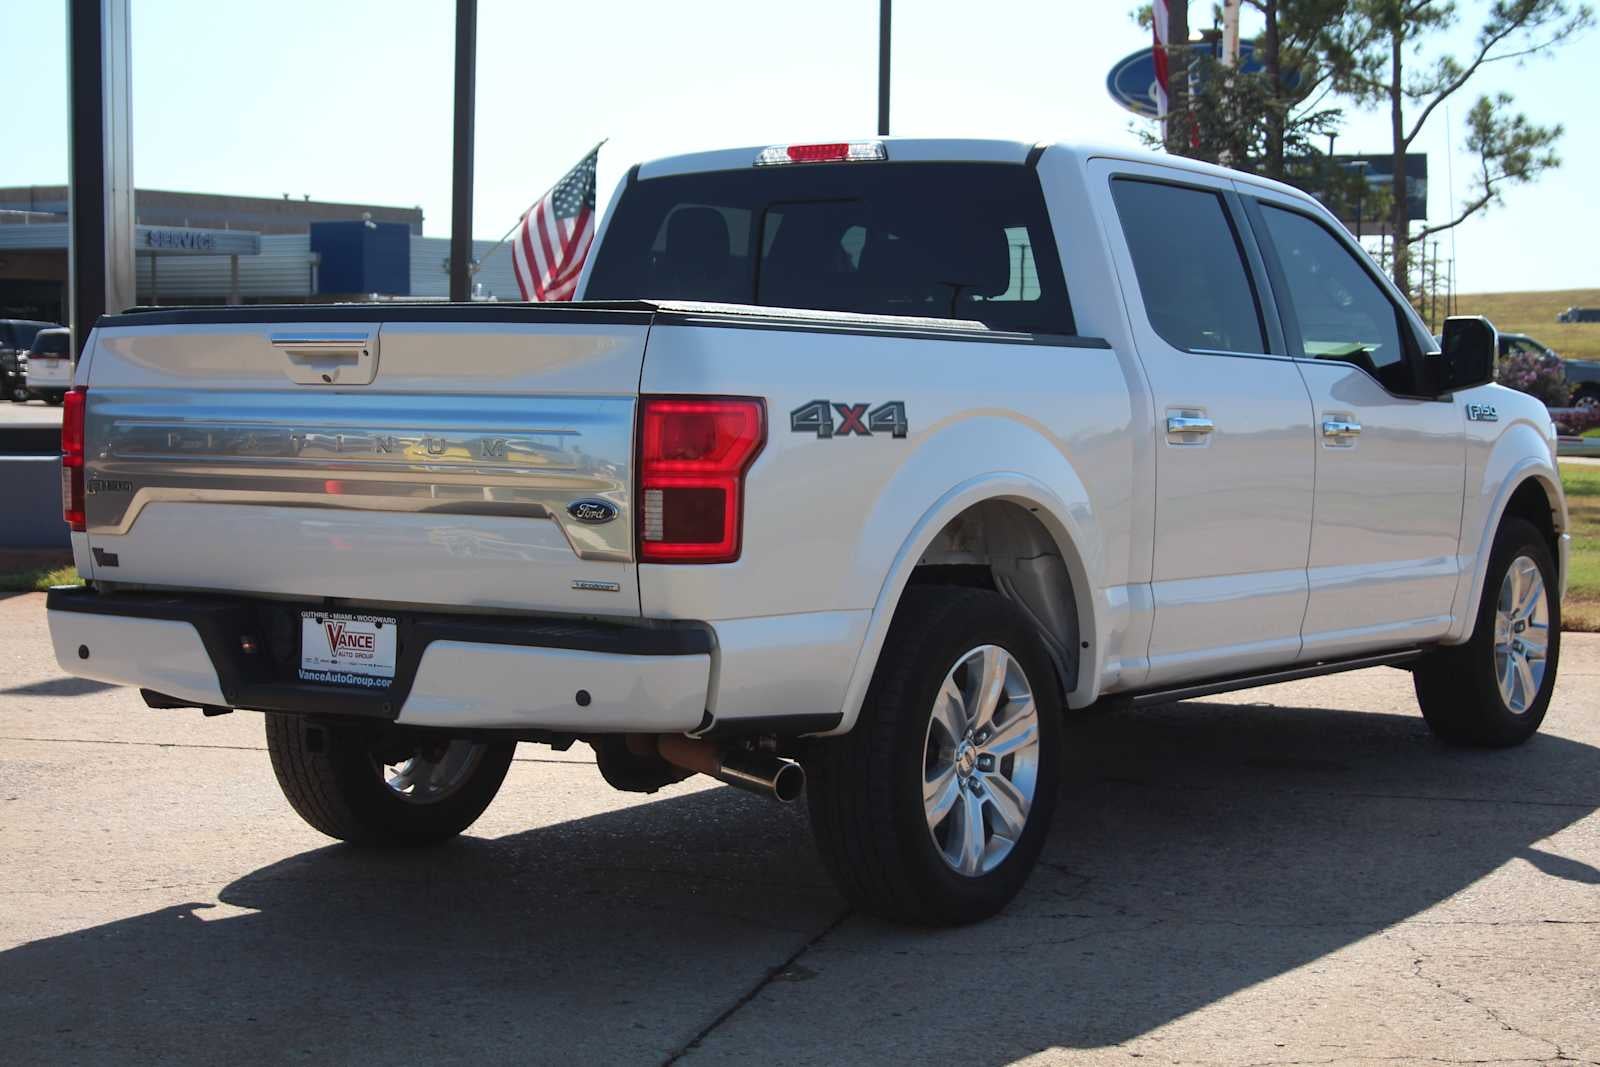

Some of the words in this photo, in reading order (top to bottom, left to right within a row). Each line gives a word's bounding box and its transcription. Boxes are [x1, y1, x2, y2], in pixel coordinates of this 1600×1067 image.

[576, 503, 605, 519] Ford
[301, 611, 329, 619] GUTHRIE
[333, 612, 353, 620] MIAMI
[356, 614, 397, 624] WOODWARD
[338, 651, 353, 659] AUTO
[354, 652, 374, 660] GROUP
